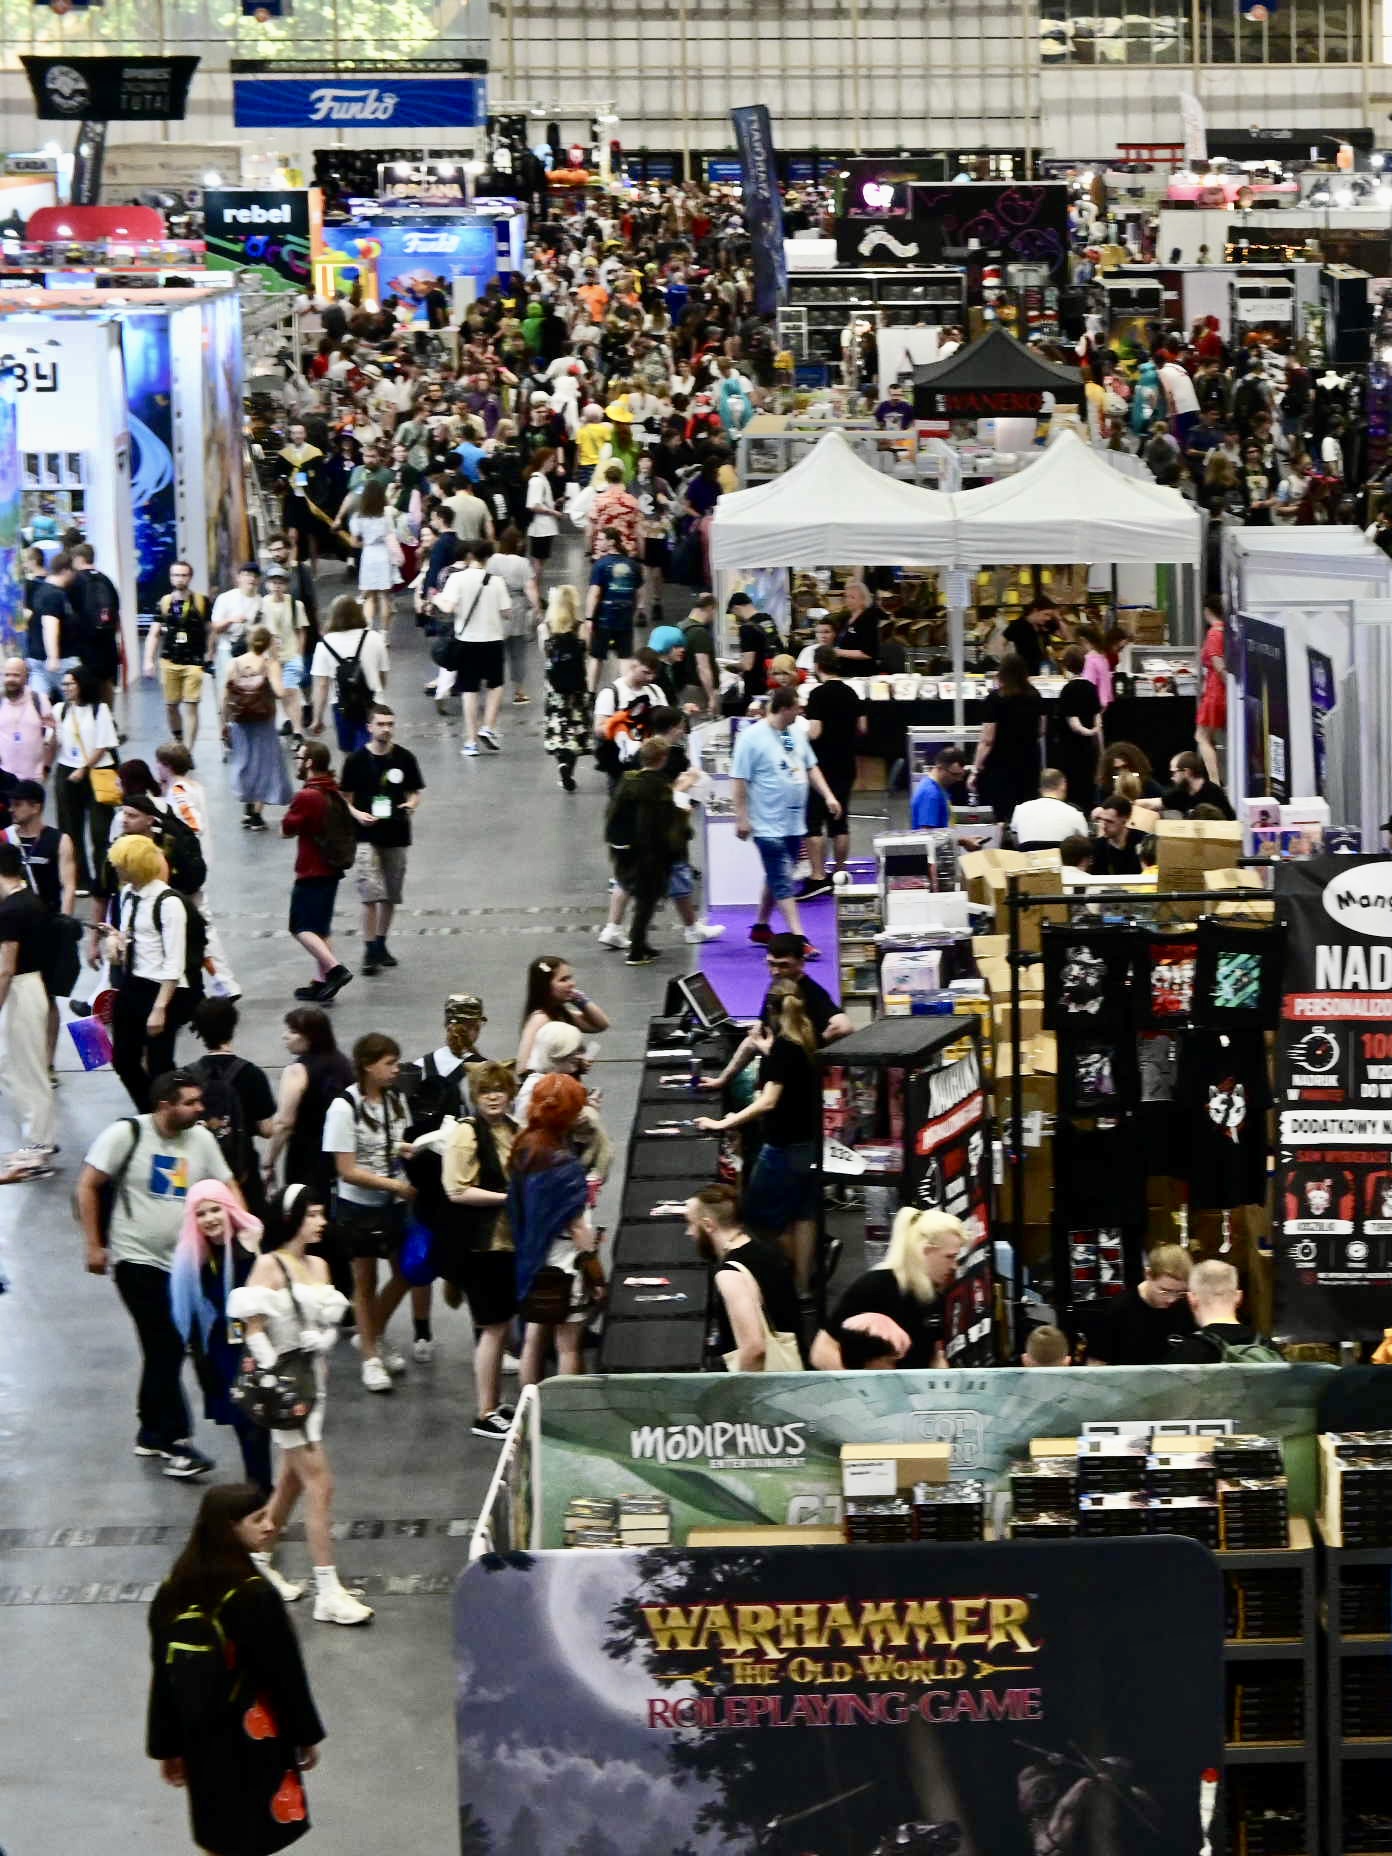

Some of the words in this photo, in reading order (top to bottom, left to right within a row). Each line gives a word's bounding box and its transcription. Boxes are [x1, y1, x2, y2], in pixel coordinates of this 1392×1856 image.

[307, 87, 400, 121] Funko
[223, 204, 292, 224] rebel
[1291, 1119, 1378, 1135] DODATKOWY
[641, 1597, 1042, 1660] WARHAMMER
[921, 1687, 1043, 1723] GAME
